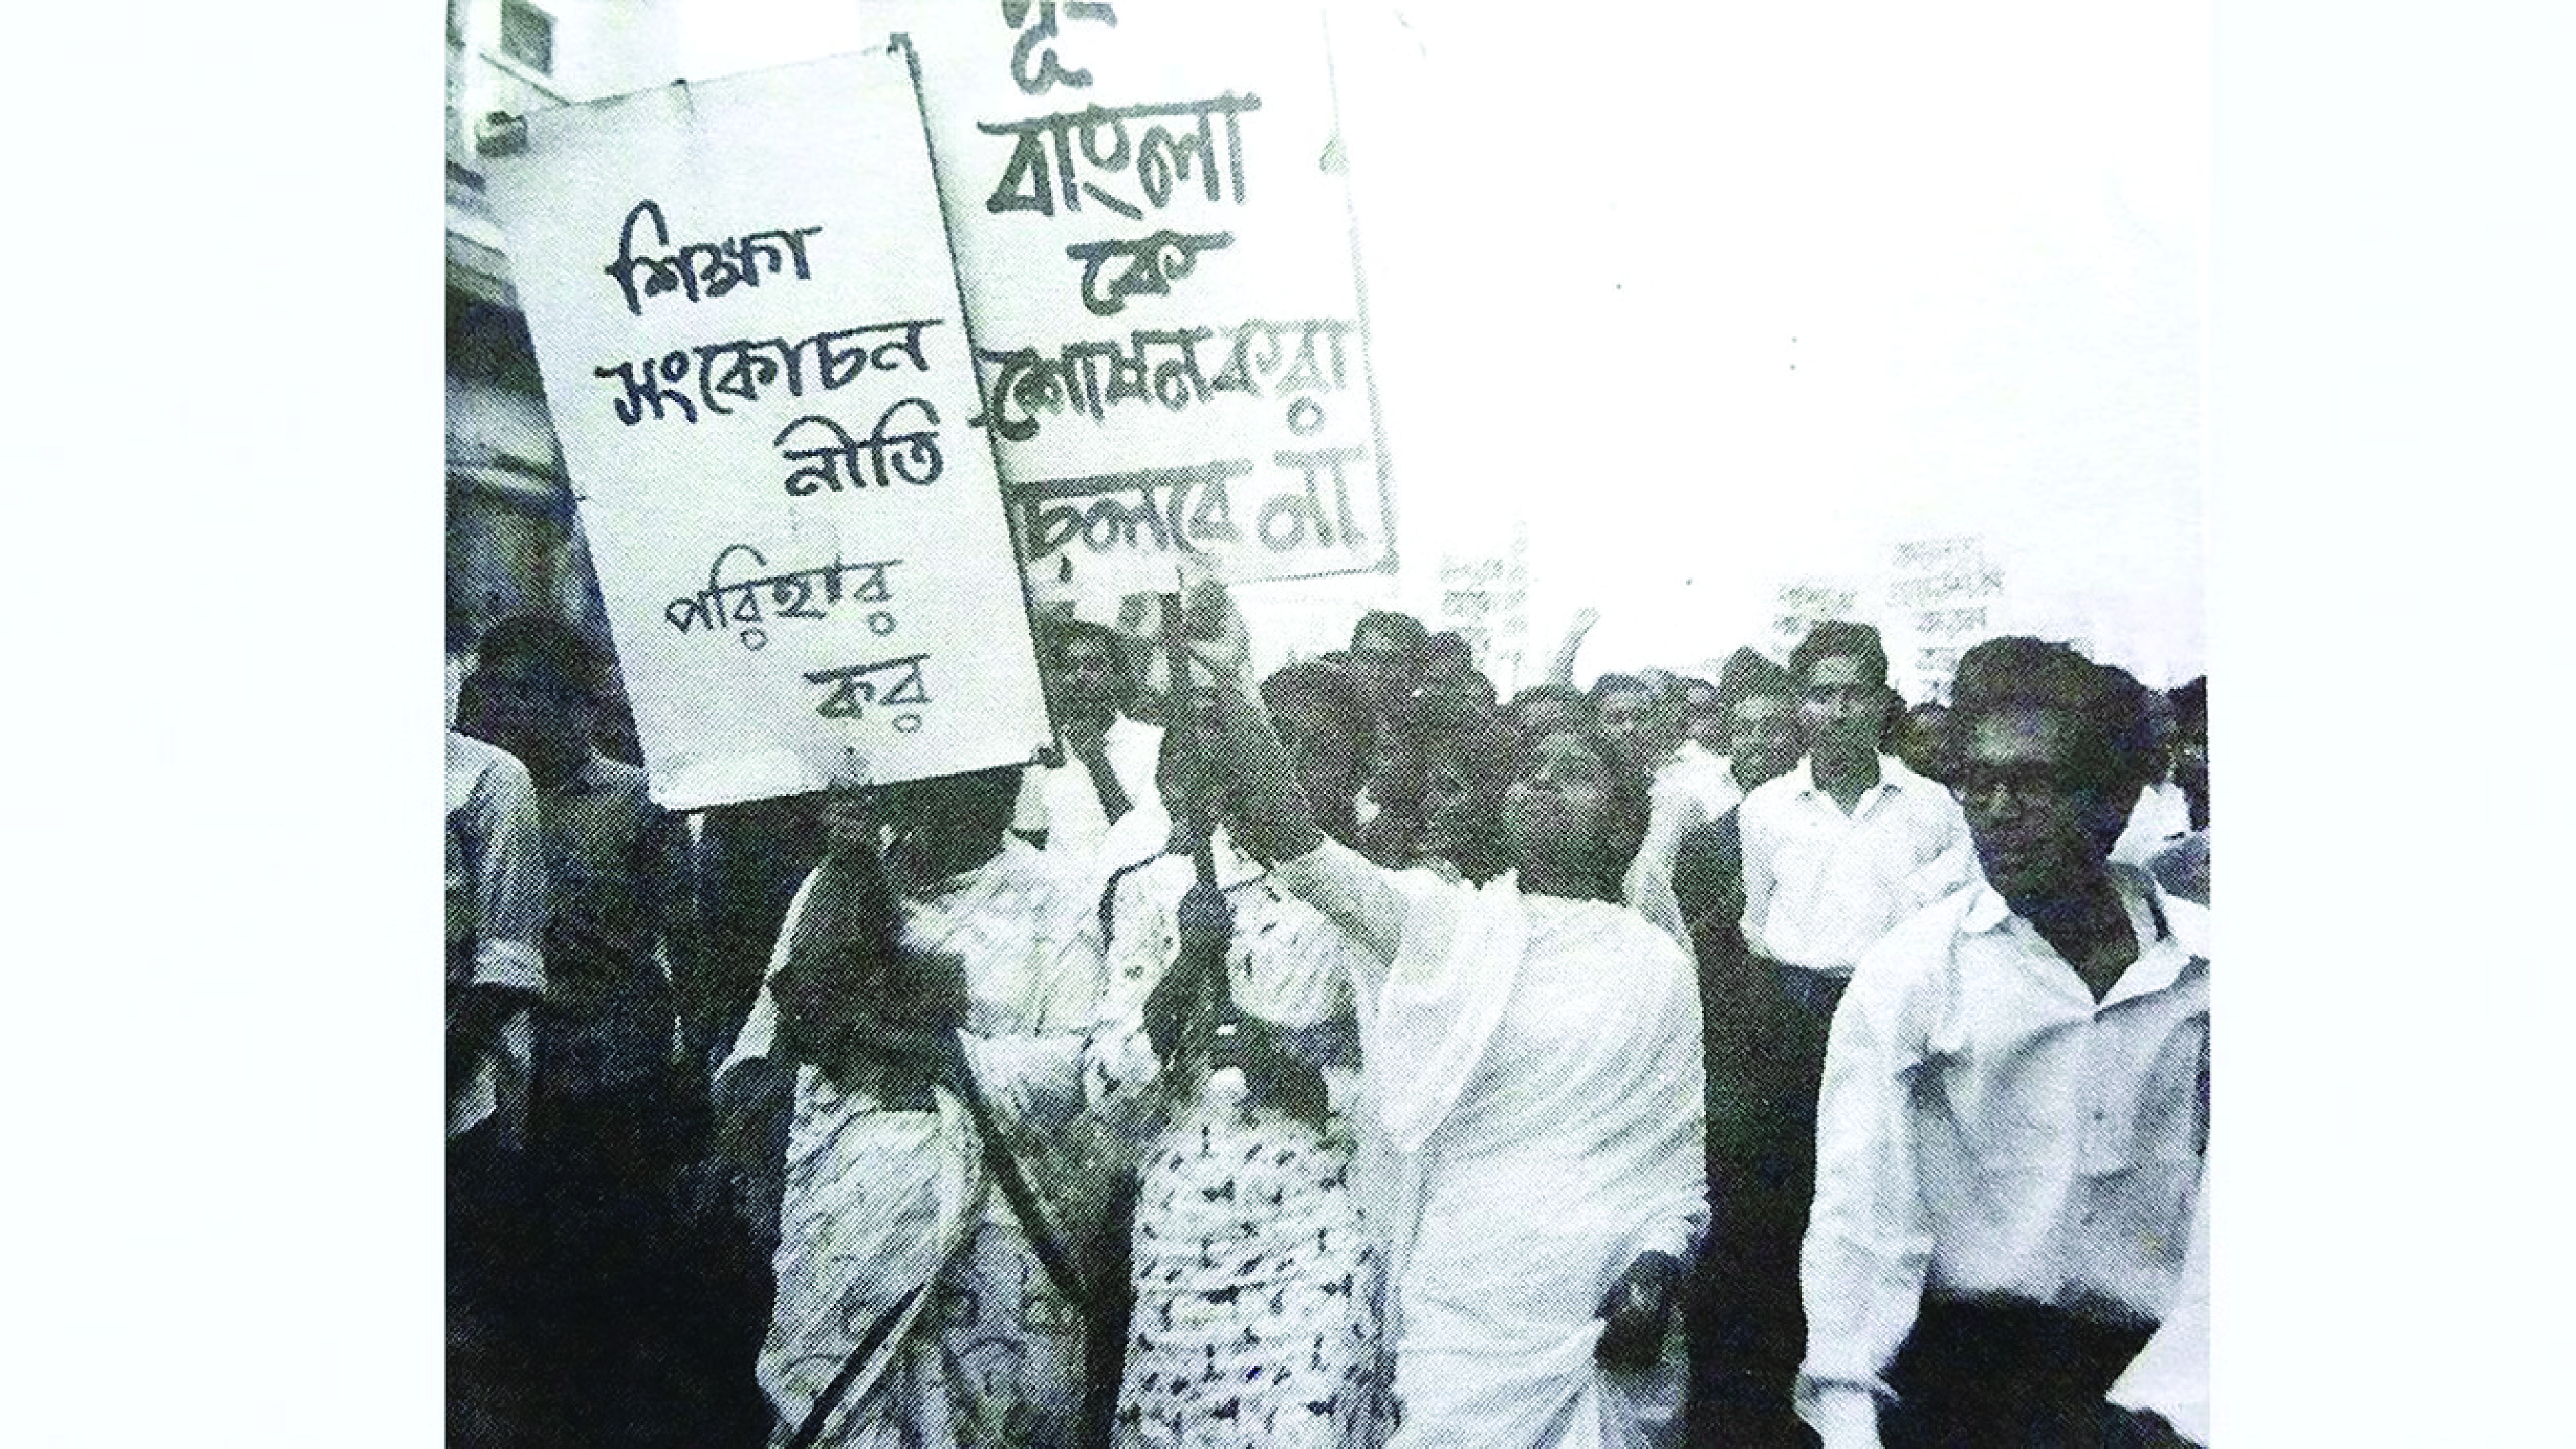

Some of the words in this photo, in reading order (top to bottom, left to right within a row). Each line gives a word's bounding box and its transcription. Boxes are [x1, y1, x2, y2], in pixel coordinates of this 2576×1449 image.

[977, 90, 1262, 221] বাংলা
[604, 198, 822, 316] শিক্ষা
[1065, 229, 1235, 316] কে
[594, 319, 945, 426] সংকোচন
[773, 397, 944, 496] নীতি
[1005, 458, 1254, 567] চলবে
[1256, 446, 1367, 553] না
[665, 544, 903, 651] পরিহার
[803, 653, 933, 734] কর
